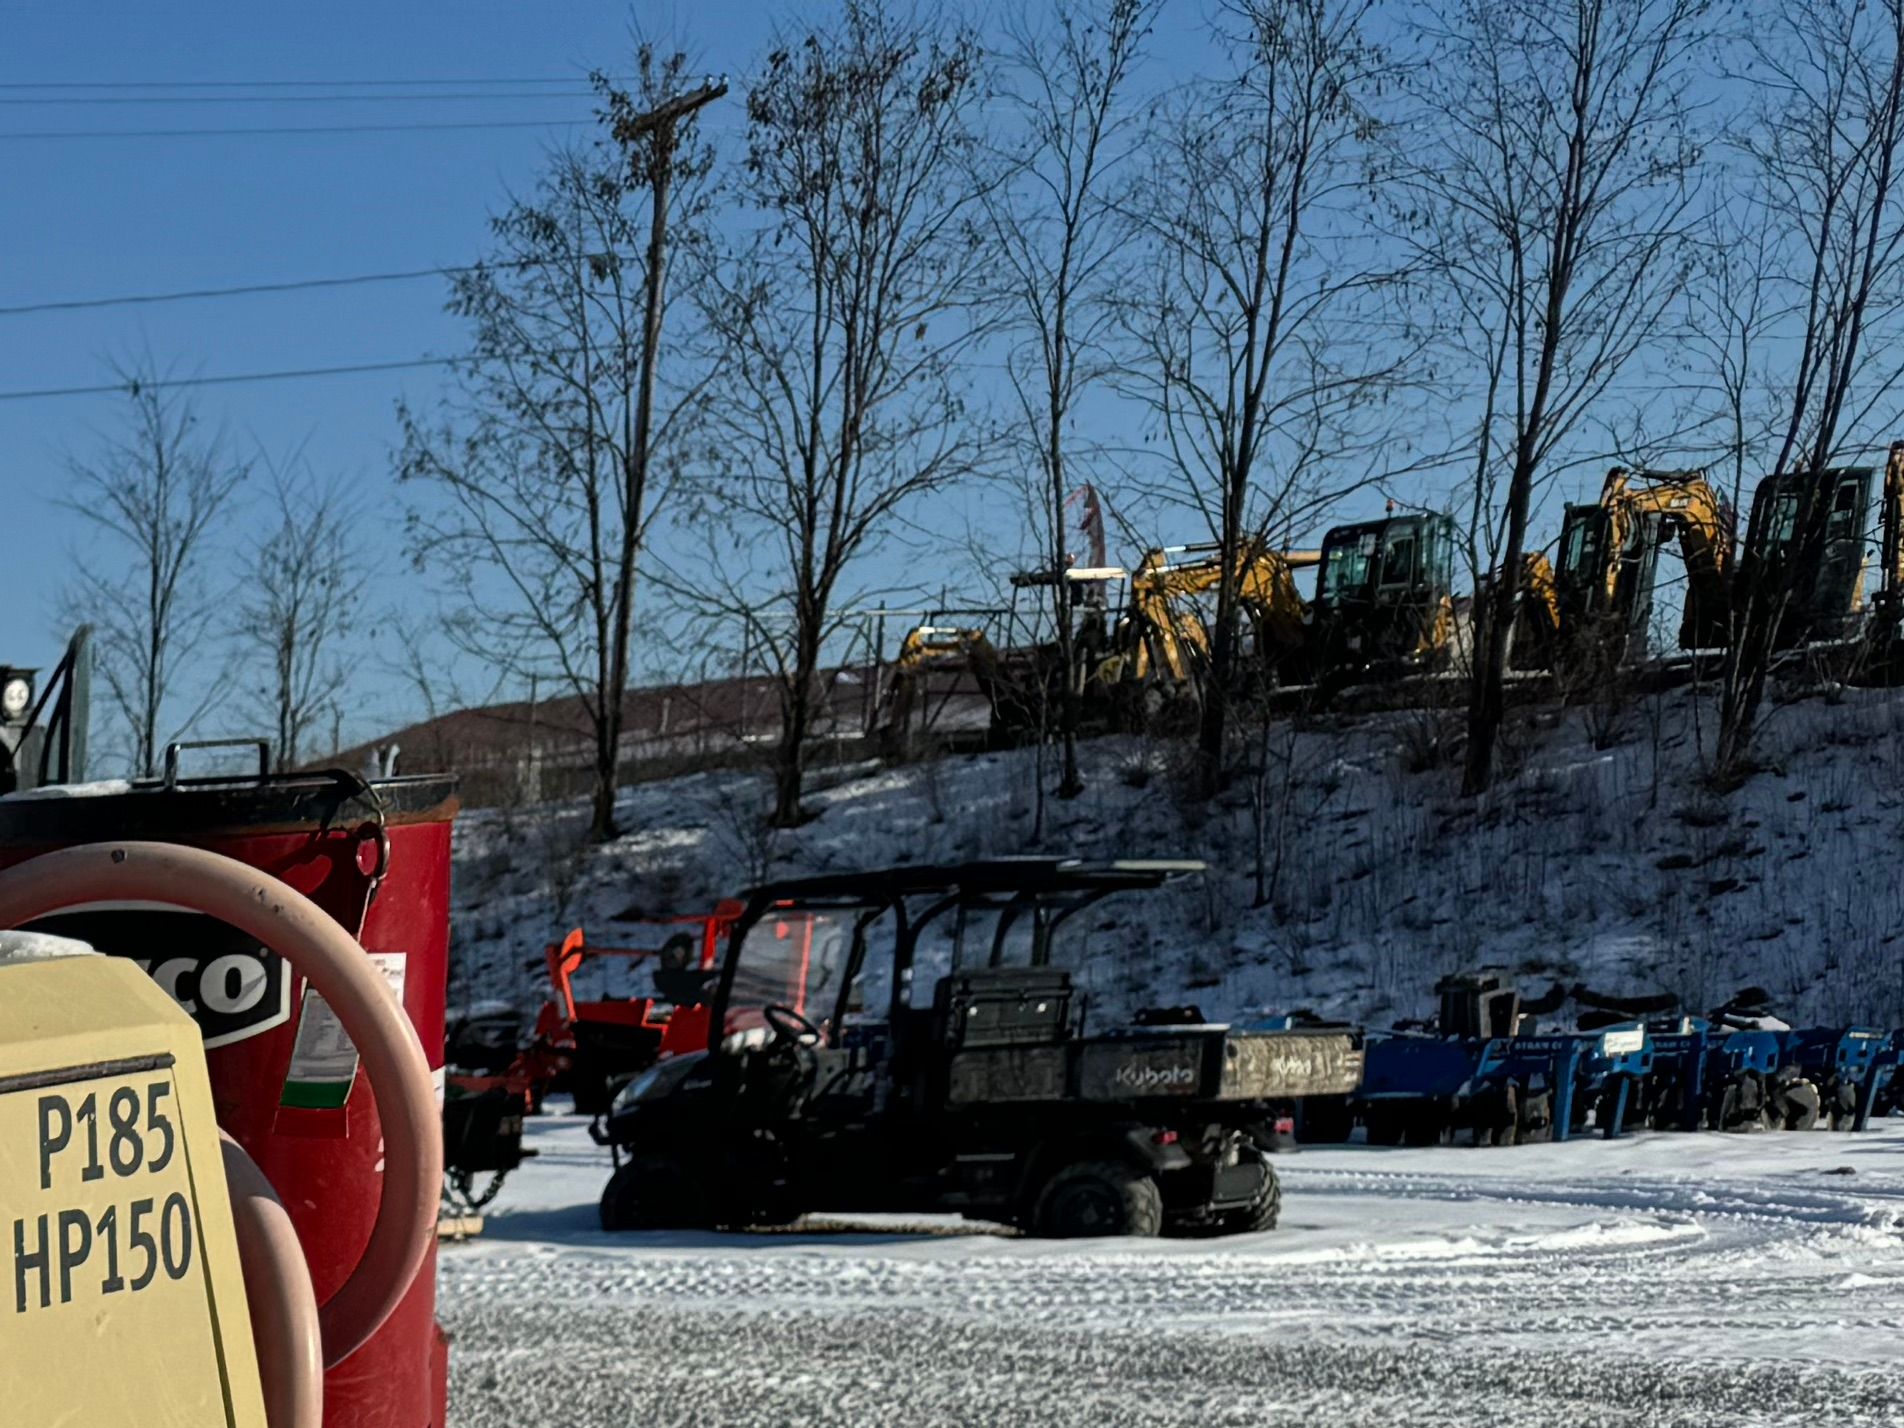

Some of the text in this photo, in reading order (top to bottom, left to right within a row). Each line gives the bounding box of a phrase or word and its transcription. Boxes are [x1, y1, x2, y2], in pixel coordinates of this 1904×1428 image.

[1116, 1065, 1194, 1087] Kubota
[38, 1080, 176, 1190] P185
[12, 1191, 193, 1313] HP150
